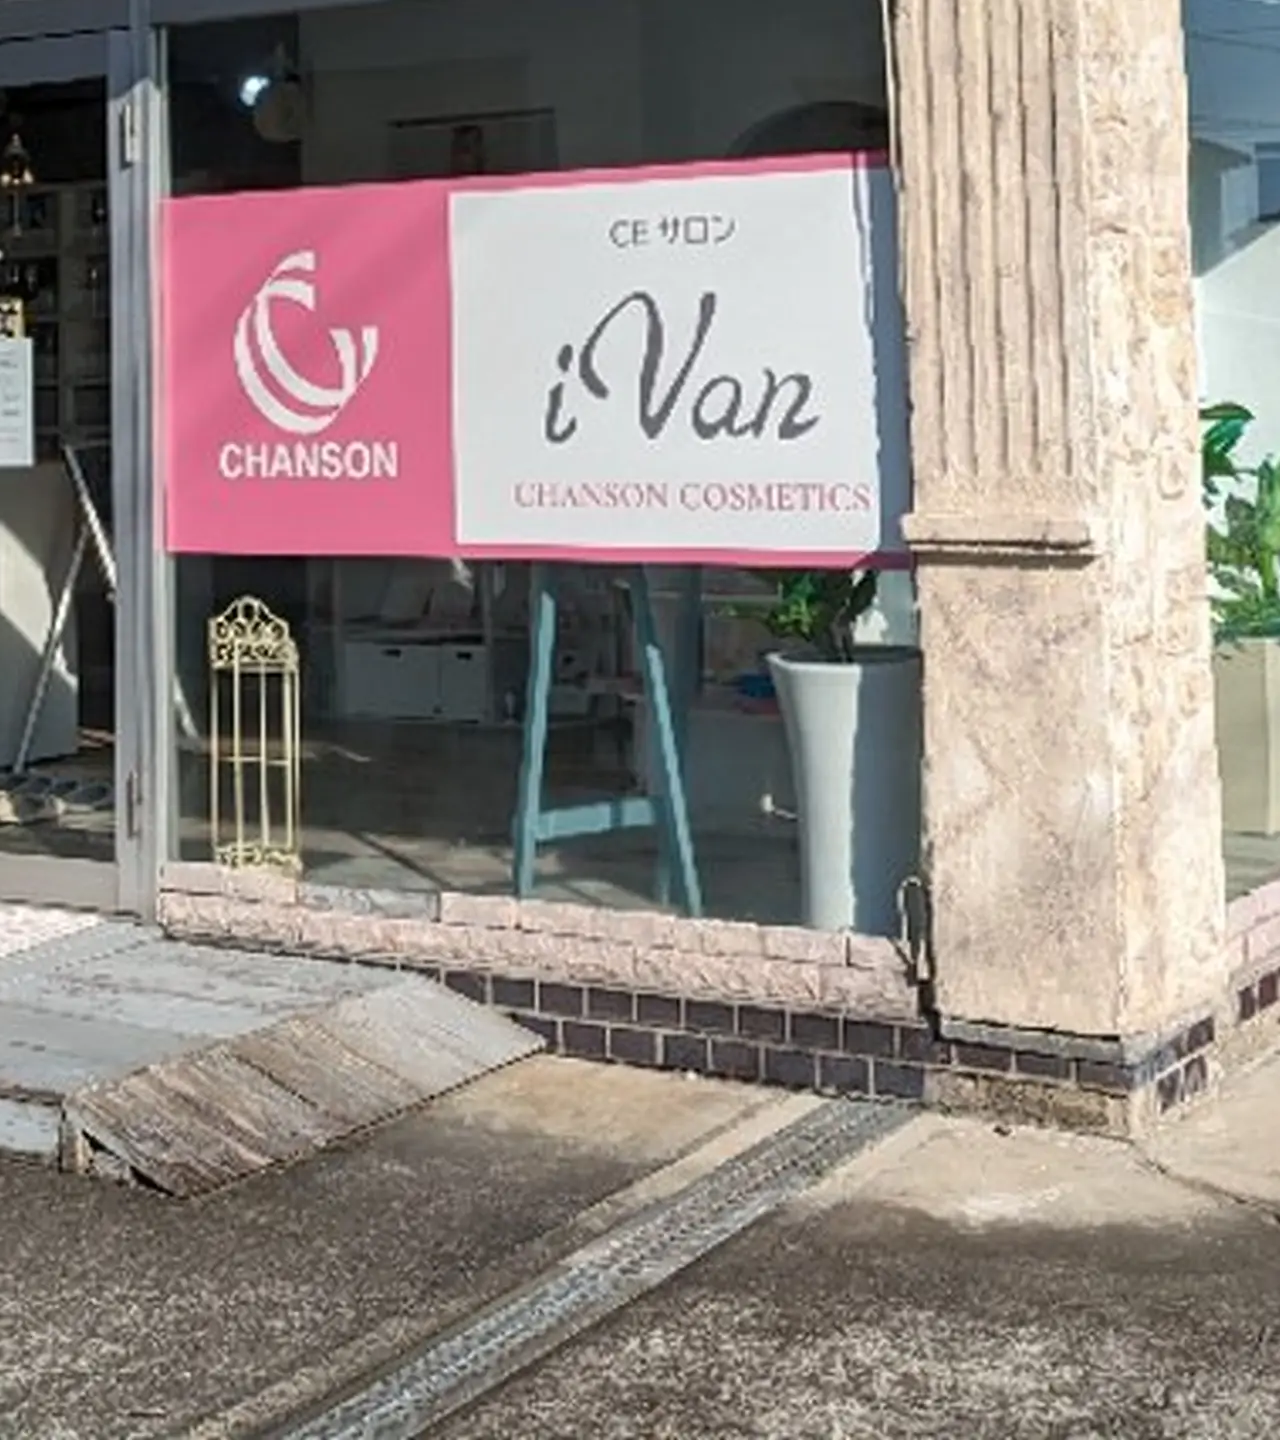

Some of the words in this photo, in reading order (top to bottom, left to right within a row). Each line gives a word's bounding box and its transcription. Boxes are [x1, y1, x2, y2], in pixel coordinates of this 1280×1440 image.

[609, 218, 649, 248] CE
[658, 215, 736, 245] サロン
[219, 441, 398, 479] CHANSON
[514, 481, 669, 510] CHANSON
[679, 481, 872, 512] COSMETICS
